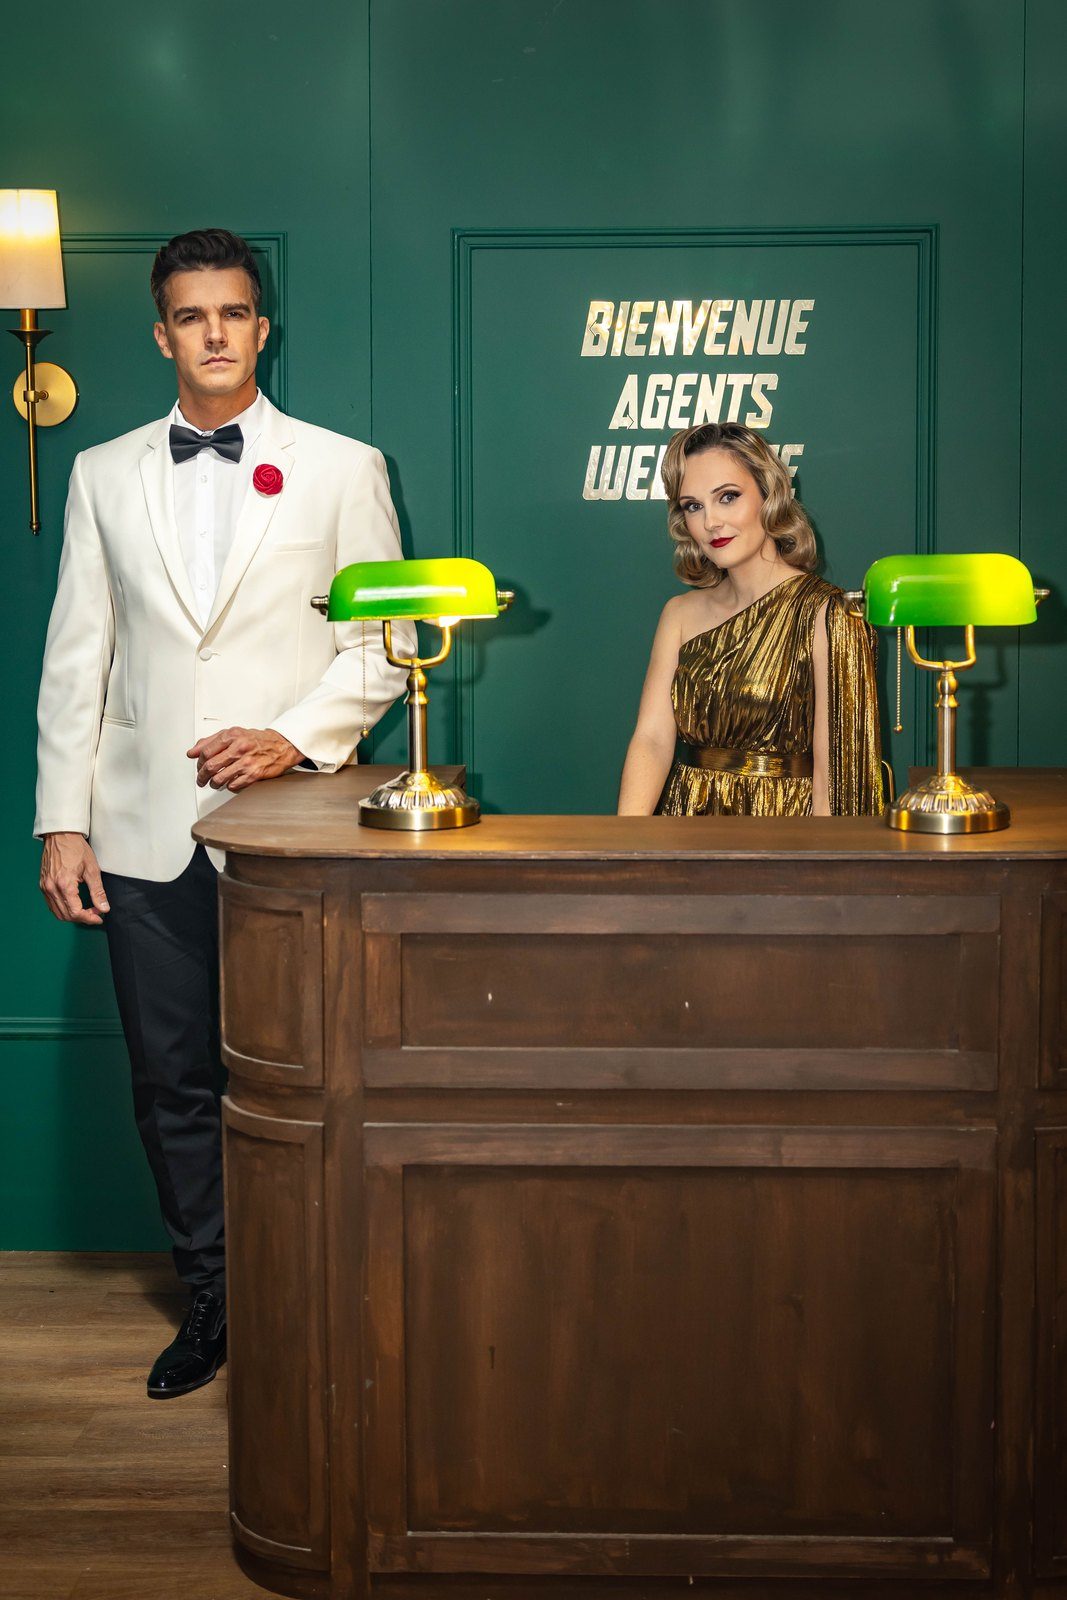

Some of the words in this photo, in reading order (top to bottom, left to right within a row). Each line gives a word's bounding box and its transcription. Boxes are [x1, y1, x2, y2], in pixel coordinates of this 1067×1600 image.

[580, 299, 815, 357] BIENVENUE
[608, 373, 778, 430] AGENTS
[582, 443, 804, 501] WELE
